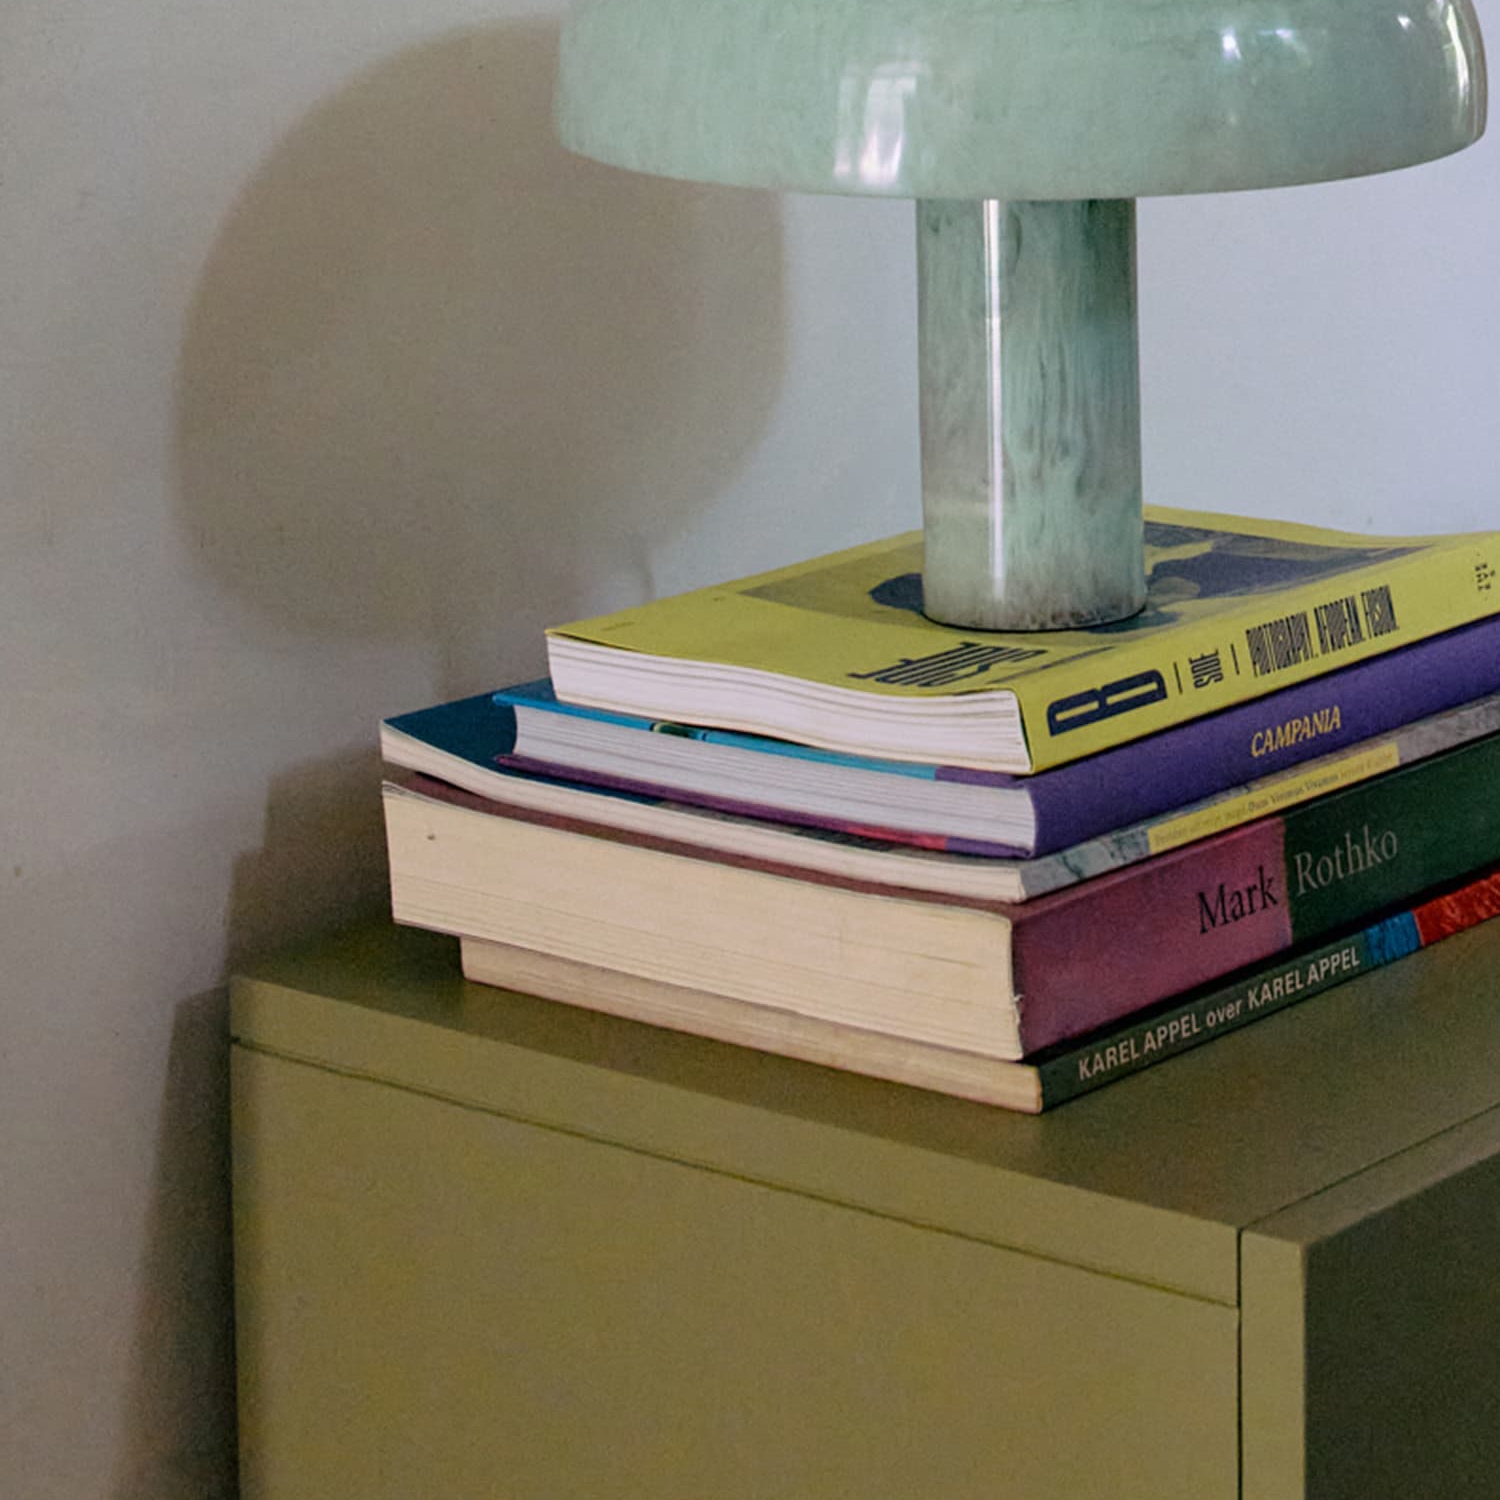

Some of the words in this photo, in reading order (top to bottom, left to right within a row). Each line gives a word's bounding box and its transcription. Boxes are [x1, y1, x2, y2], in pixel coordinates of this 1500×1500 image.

[1046, 669, 1168, 736] B
[1188, 649, 1224, 688] SIDE
[1251, 705, 1342, 757] CAMPANIA
[1198, 865, 1279, 935] Mark
[1294, 825, 1398, 896] Rothko
[1078, 1039, 1140, 1081] KAREL
[1143, 1012, 1201, 1058] APPEL
[1205, 999, 1242, 1029] over
[1247, 974, 1304, 1010] KAREL
[1308, 947, 1361, 986] APPEL
